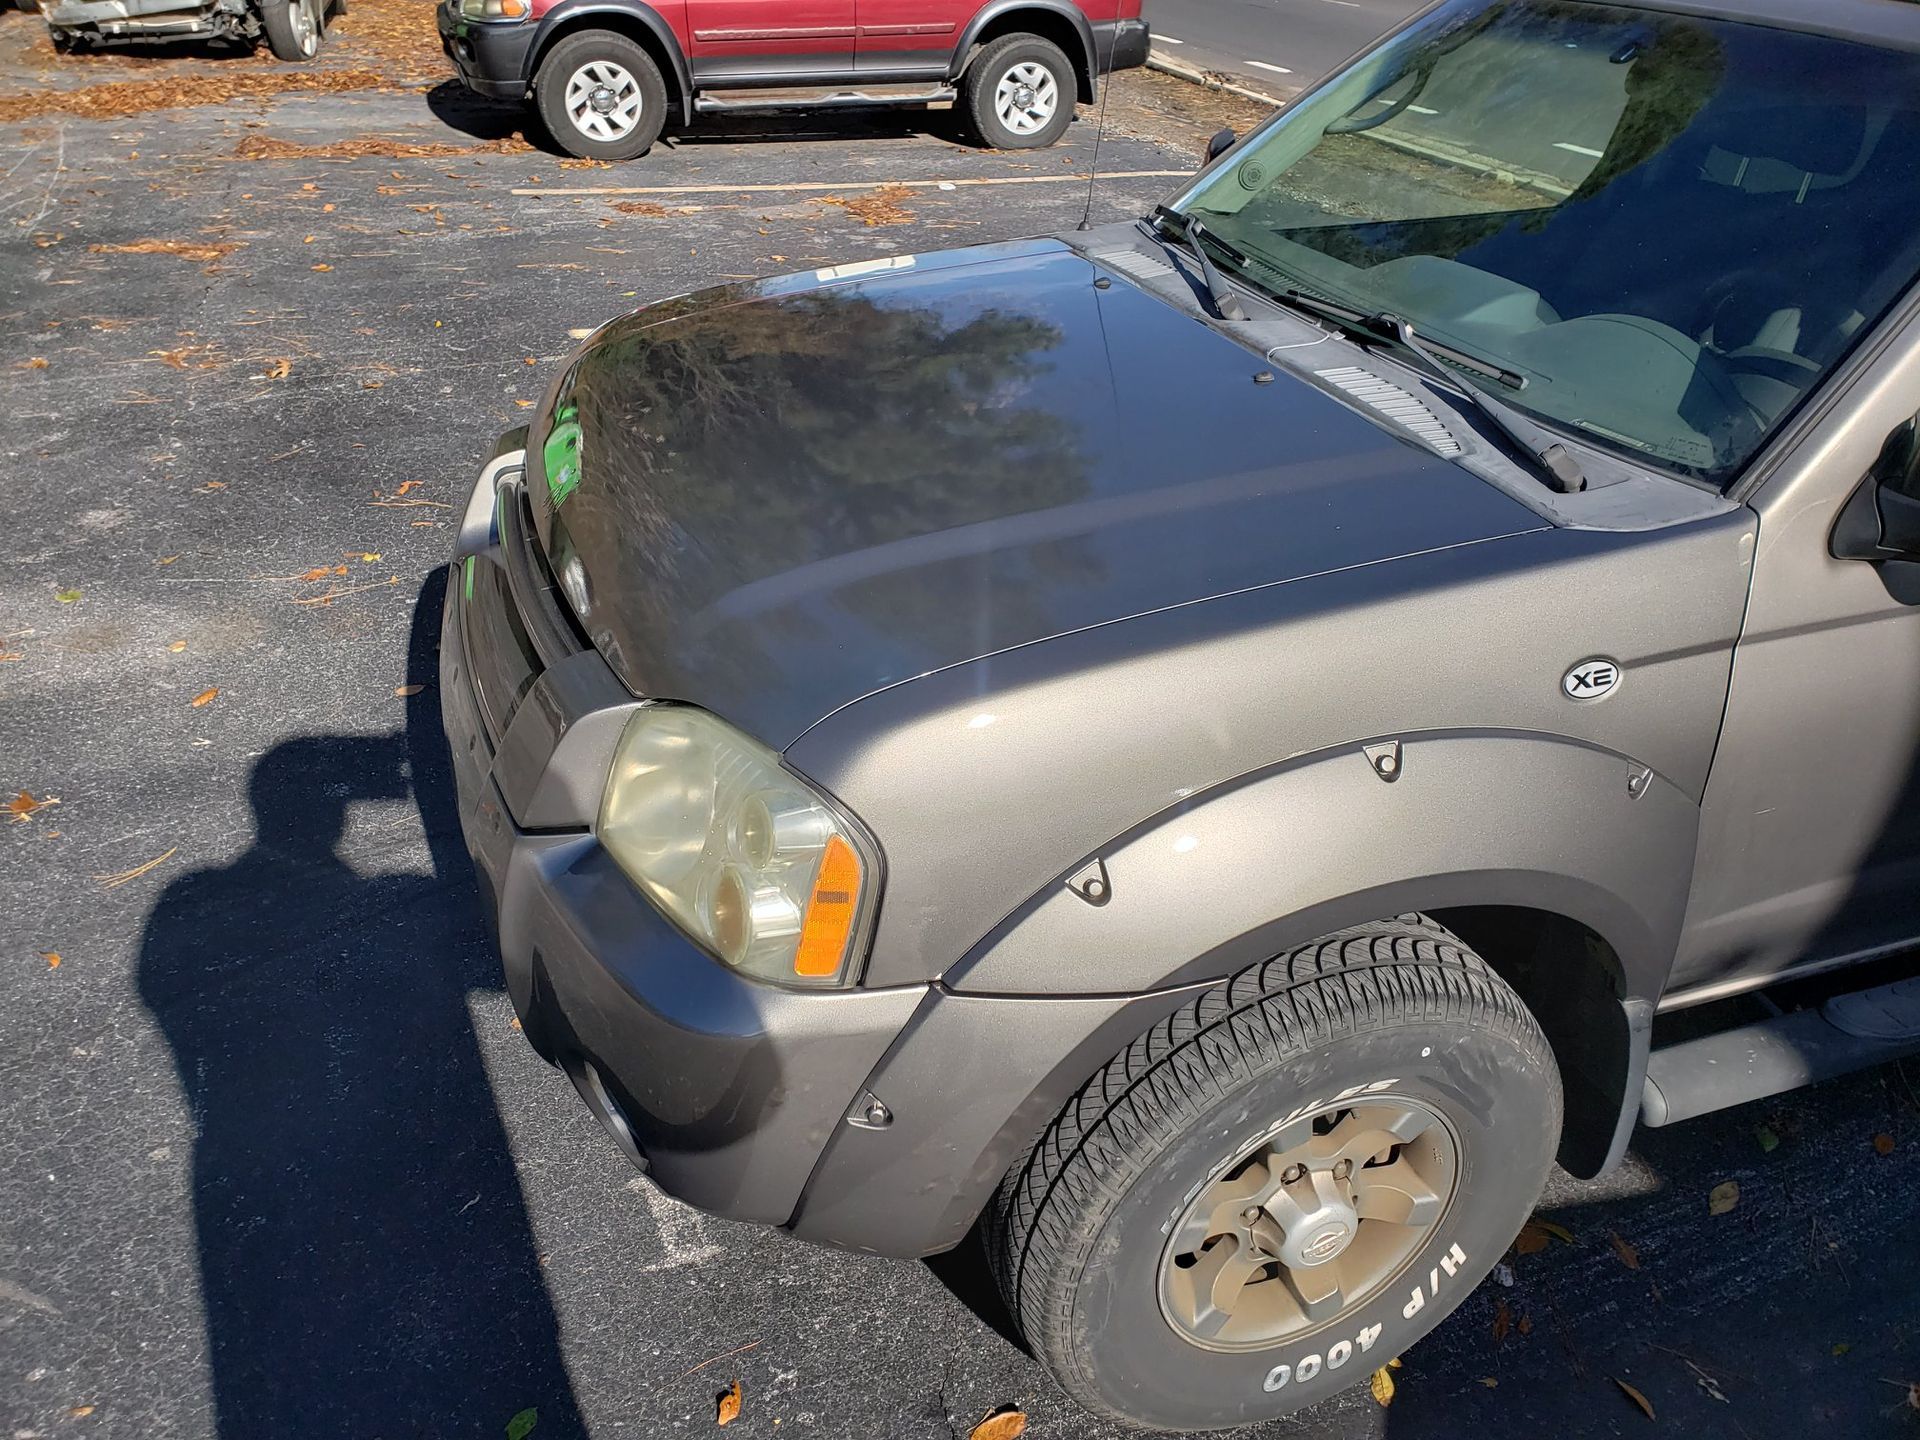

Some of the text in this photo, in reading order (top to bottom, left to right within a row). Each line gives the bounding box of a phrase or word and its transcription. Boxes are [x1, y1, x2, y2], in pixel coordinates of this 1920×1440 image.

[1571, 667, 1613, 692] XE
[1263, 1242, 1467, 1393] H/P 4000
